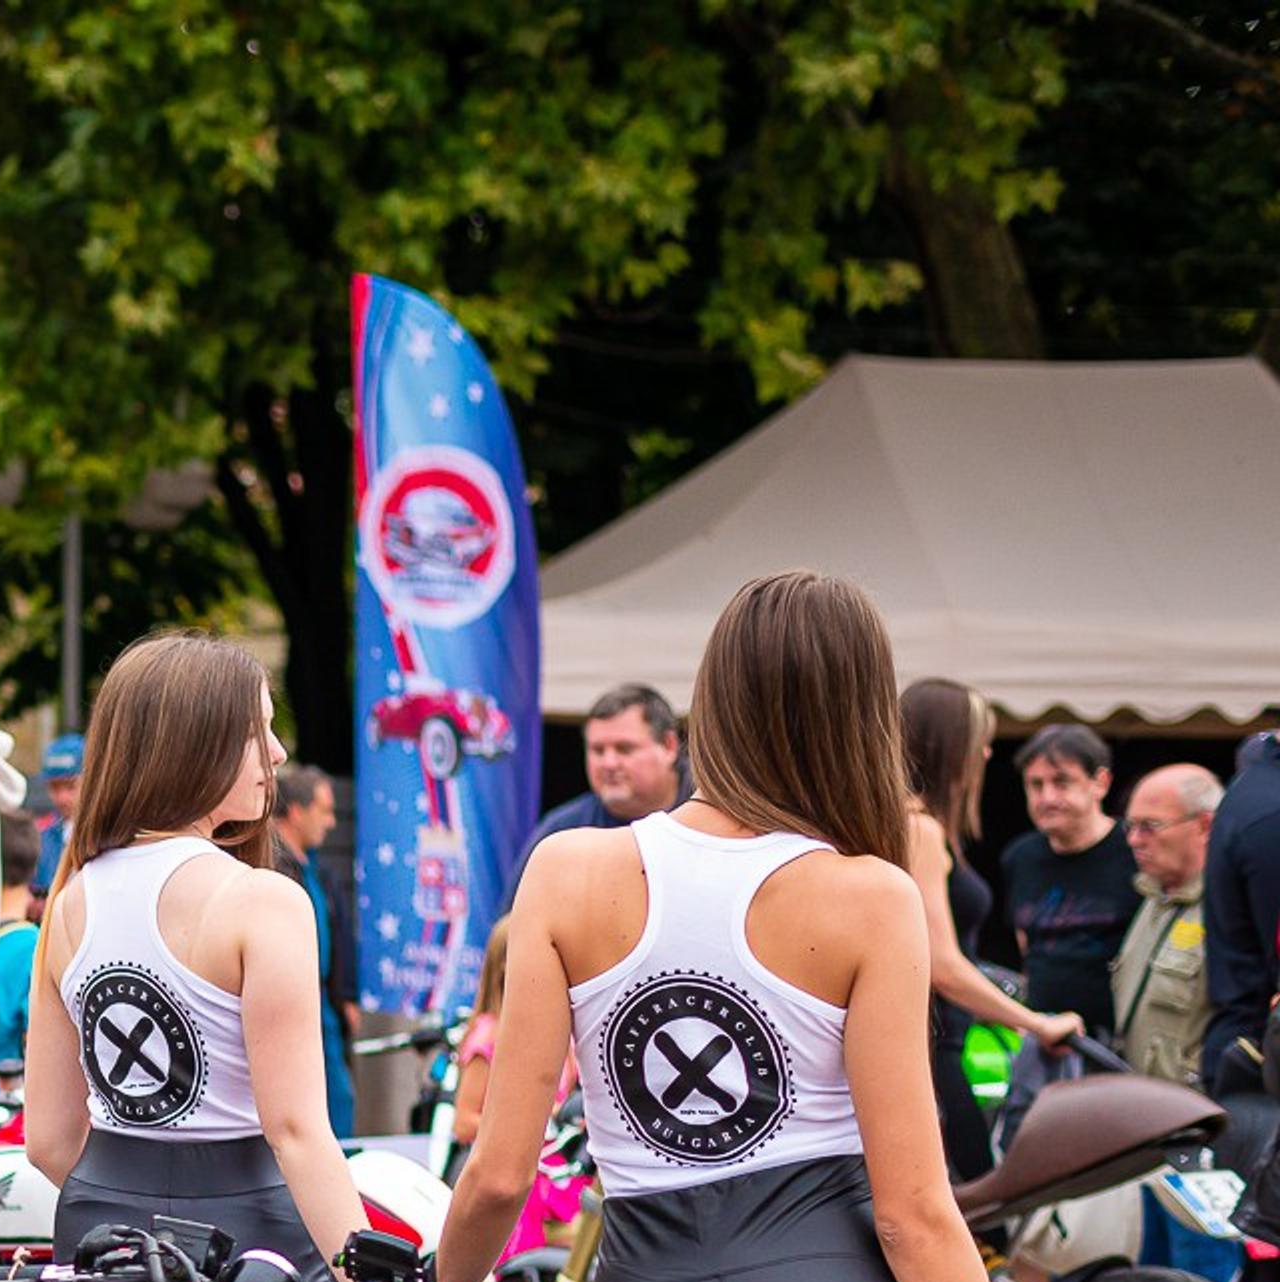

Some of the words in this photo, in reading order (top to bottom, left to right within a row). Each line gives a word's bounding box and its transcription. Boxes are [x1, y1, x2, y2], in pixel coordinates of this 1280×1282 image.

[652, 996, 730, 1019] RACER
[735, 1021, 769, 1077] CLUB
[652, 1116, 756, 1149] BULGARIA
